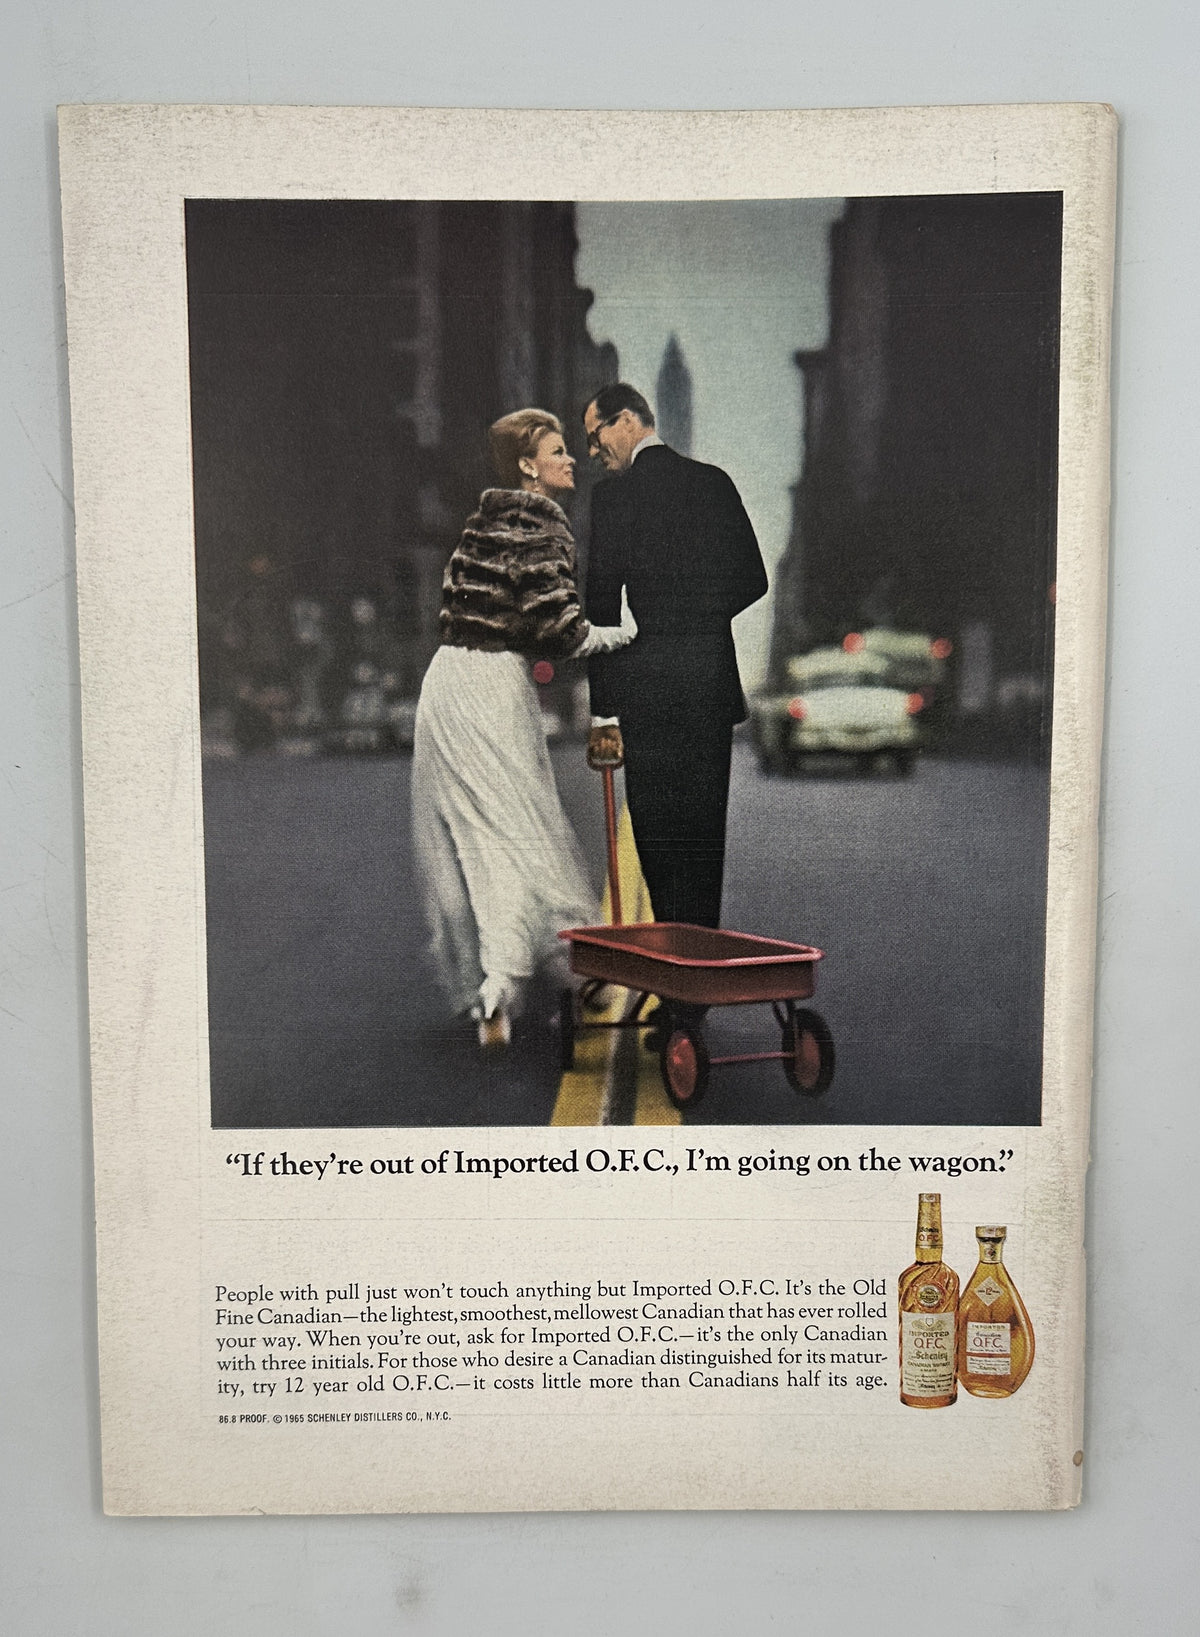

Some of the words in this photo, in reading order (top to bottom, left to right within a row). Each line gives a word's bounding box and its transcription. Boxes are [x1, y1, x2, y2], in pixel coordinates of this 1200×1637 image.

[225, 1151, 266, 1177] “If
[269, 1151, 364, 1181] they’re
[369, 1155, 415, 1175] out
[420, 1149, 450, 1175] of
[452, 1148, 580, 1180] Imported
[585, 1148, 679, 1177] O.F.C.,
[685, 1148, 732, 1172] I’m
[737, 1148, 811, 1177] going
[816, 1155, 853, 1172] on
[857, 1146, 902, 1172] the
[907, 1148, 1014, 1178] wagon.”
[215, 1283, 274, 1306] People
[279, 1283, 320, 1301] with
[325, 1282, 361, 1305] pull
[365, 1284, 398, 1304] just
[403, 1282, 454, 1299] won’t
[459, 1280, 510, 1299] touch
[515, 1279, 592, 1302] anything
[596, 1279, 627, 1297] but
[632, 1278, 713, 1301] Imported
[718, 1279, 780, 1296] O.F.C.
[785, 1278, 812, 1296] It’s
[817, 1278, 846, 1296] the
[852, 1278, 887, 1296] Old
[215, 1308, 255, 1326] Fine
[390, 1304, 458, 1327] lightest,
[459, 1303, 552, 1324] smoothest,
[553, 1302, 639, 1321] mellowest
[641, 1301, 726, 1320] Canadian
[728, 1301, 764, 1319] that
[766, 1301, 795, 1319] has
[798, 1307, 834, 1319] ever
[836, 1300, 888, 1319] rolled
[215, 1337, 257, 1353] your
[261, 1336, 302, 1352] way.
[304, 1328, 362, 1347] When
[366, 1328, 422, 1350] you’re
[426, 1332, 461, 1348] out,
[467, 1326, 495, 1345] ask
[499, 1326, 526, 1344] for
[531, 1325, 611, 1348] Imported
[726, 1324, 755, 1342] the
[760, 1324, 799, 1346] only
[803, 1323, 889, 1342] Canadian
[216, 1353, 257, 1372] with
[261, 1353, 307, 1371] three
[311, 1351, 374, 1370] initials.
[377, 1351, 408, 1369] For
[411, 1350, 458, 1369] those
[461, 1349, 500, 1368] who
[504, 1349, 554, 1367] desire
[558, 1355, 569, 1367] a
[572, 1347, 657, 1366] Canadian
[659, 1346, 773, 1369] distinguished
[777, 1346, 803, 1365] for
[806, 1348, 826, 1365] its
[829, 1351, 888, 1364] matur-
[217, 1379, 245, 1398] ity,
[252, 1381, 278, 1398] try
[285, 1376, 305, 1394] 12
[312, 1381, 350, 1397] year
[356, 1374, 386, 1393] old
[493, 1377, 535, 1390] costs
[541, 1371, 582, 1390] little
[588, 1377, 634, 1389] more
[640, 1370, 681, 1389] than
[688, 1369, 779, 1388] Canadians
[786, 1369, 822, 1387] half
[827, 1371, 848, 1387] its
[855, 1375, 888, 1391] age.
[218, 1414, 237, 1424] 86.8
[239, 1413, 270, 1424] PROOF.
[284, 1413, 305, 1425] 1965
[307, 1412, 352, 1423] SCHENLEY
[353, 1411, 403, 1422] DISTILLERS
[405, 1411, 423, 1423] CO.,
[425, 1410, 452, 1421] N.Y.C.
